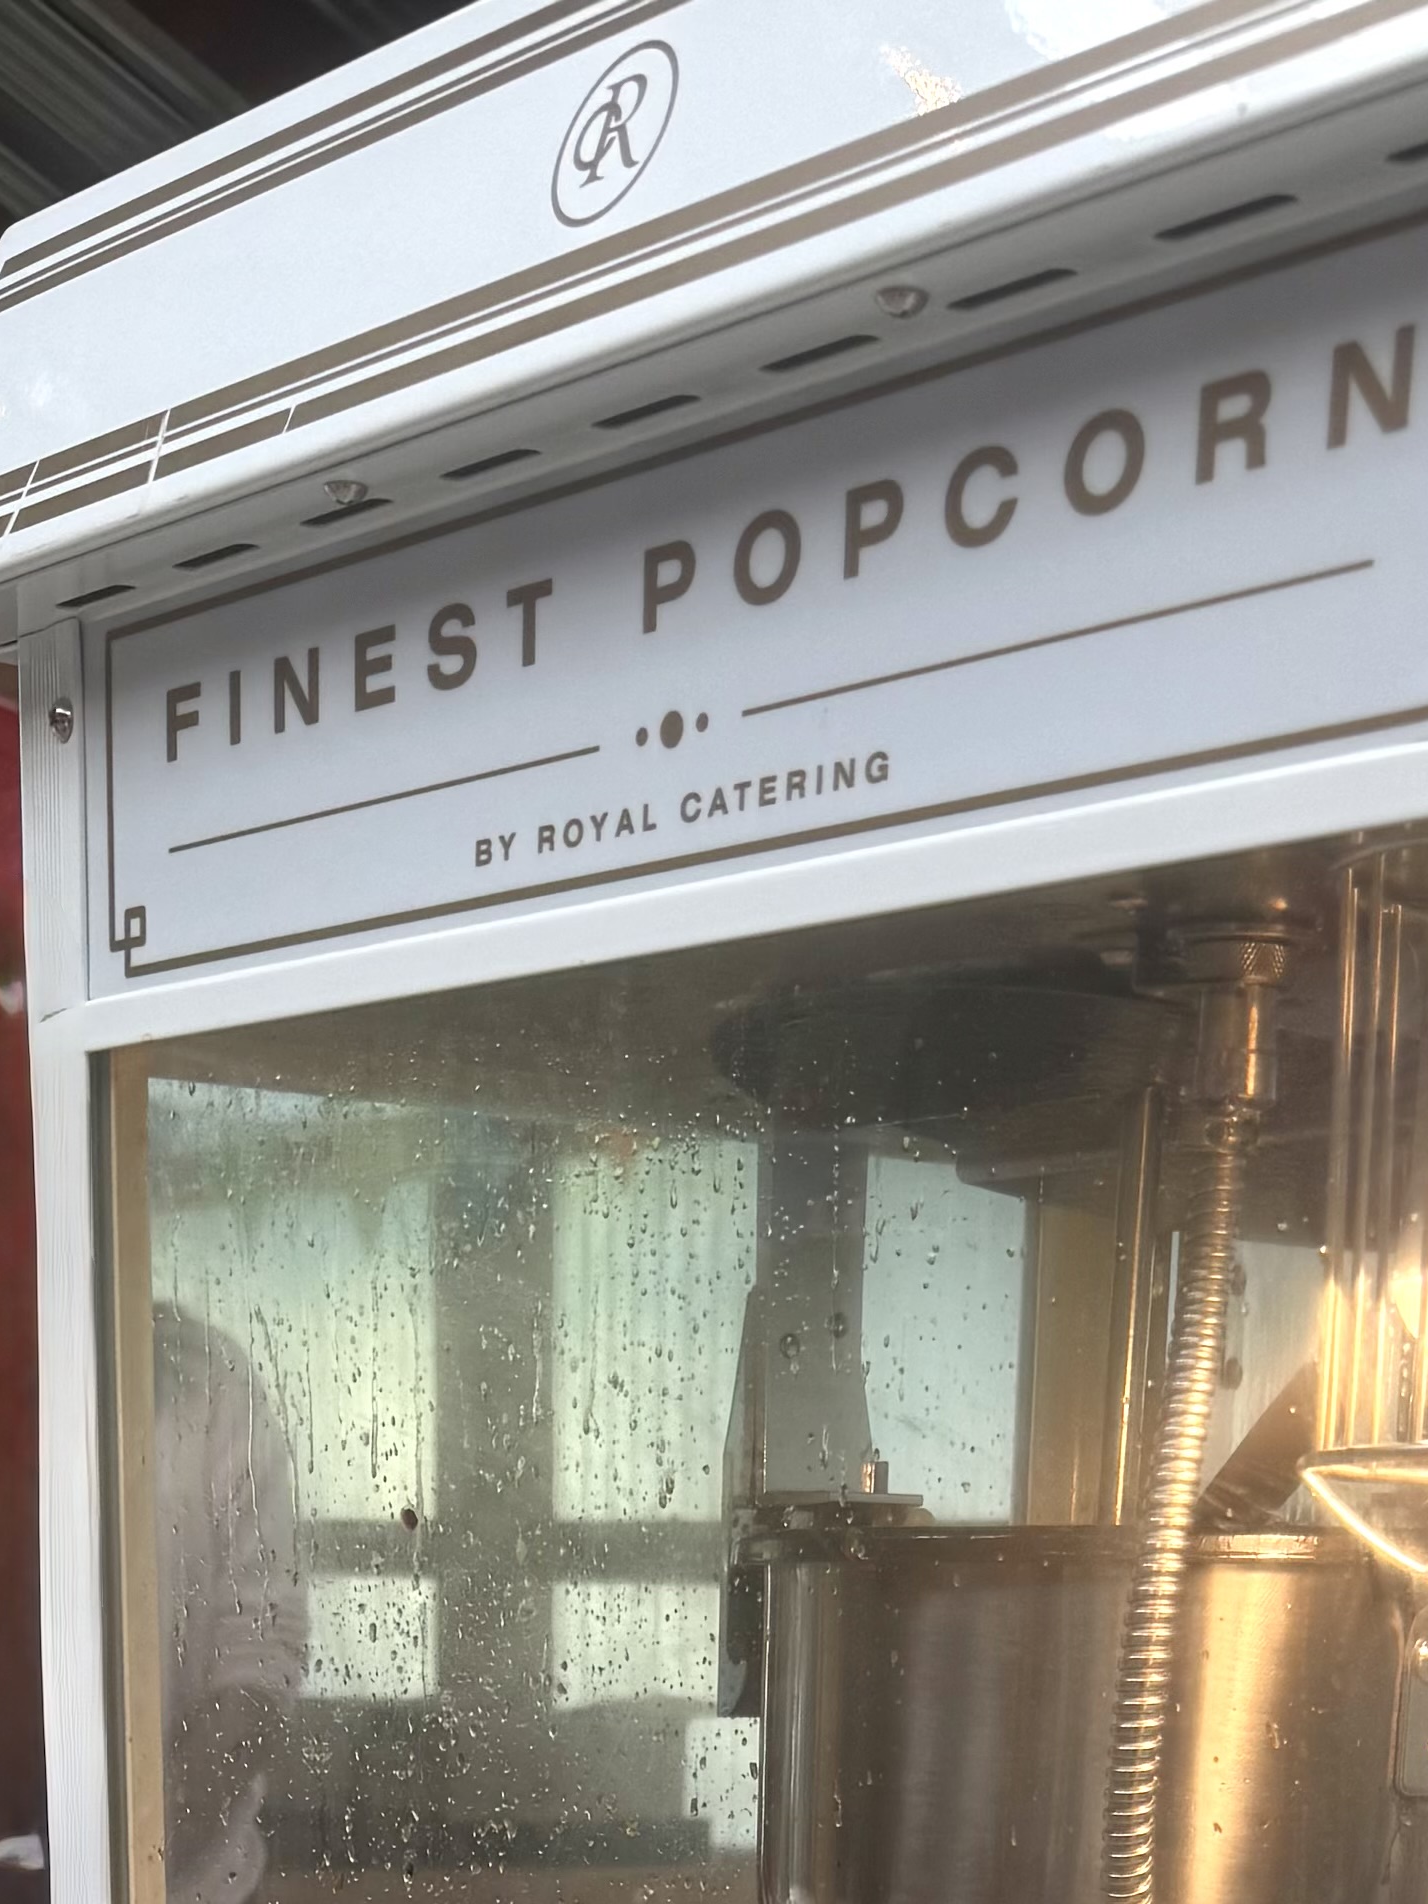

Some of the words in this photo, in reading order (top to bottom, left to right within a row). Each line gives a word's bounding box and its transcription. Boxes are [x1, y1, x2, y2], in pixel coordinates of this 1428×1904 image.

[164, 577, 553, 764] FINEST
[640, 323, 1417, 636] POPCORN
[473, 831, 517, 868] BY
[535, 802, 658, 856] ROYAL
[678, 749, 890, 825] CATERING
